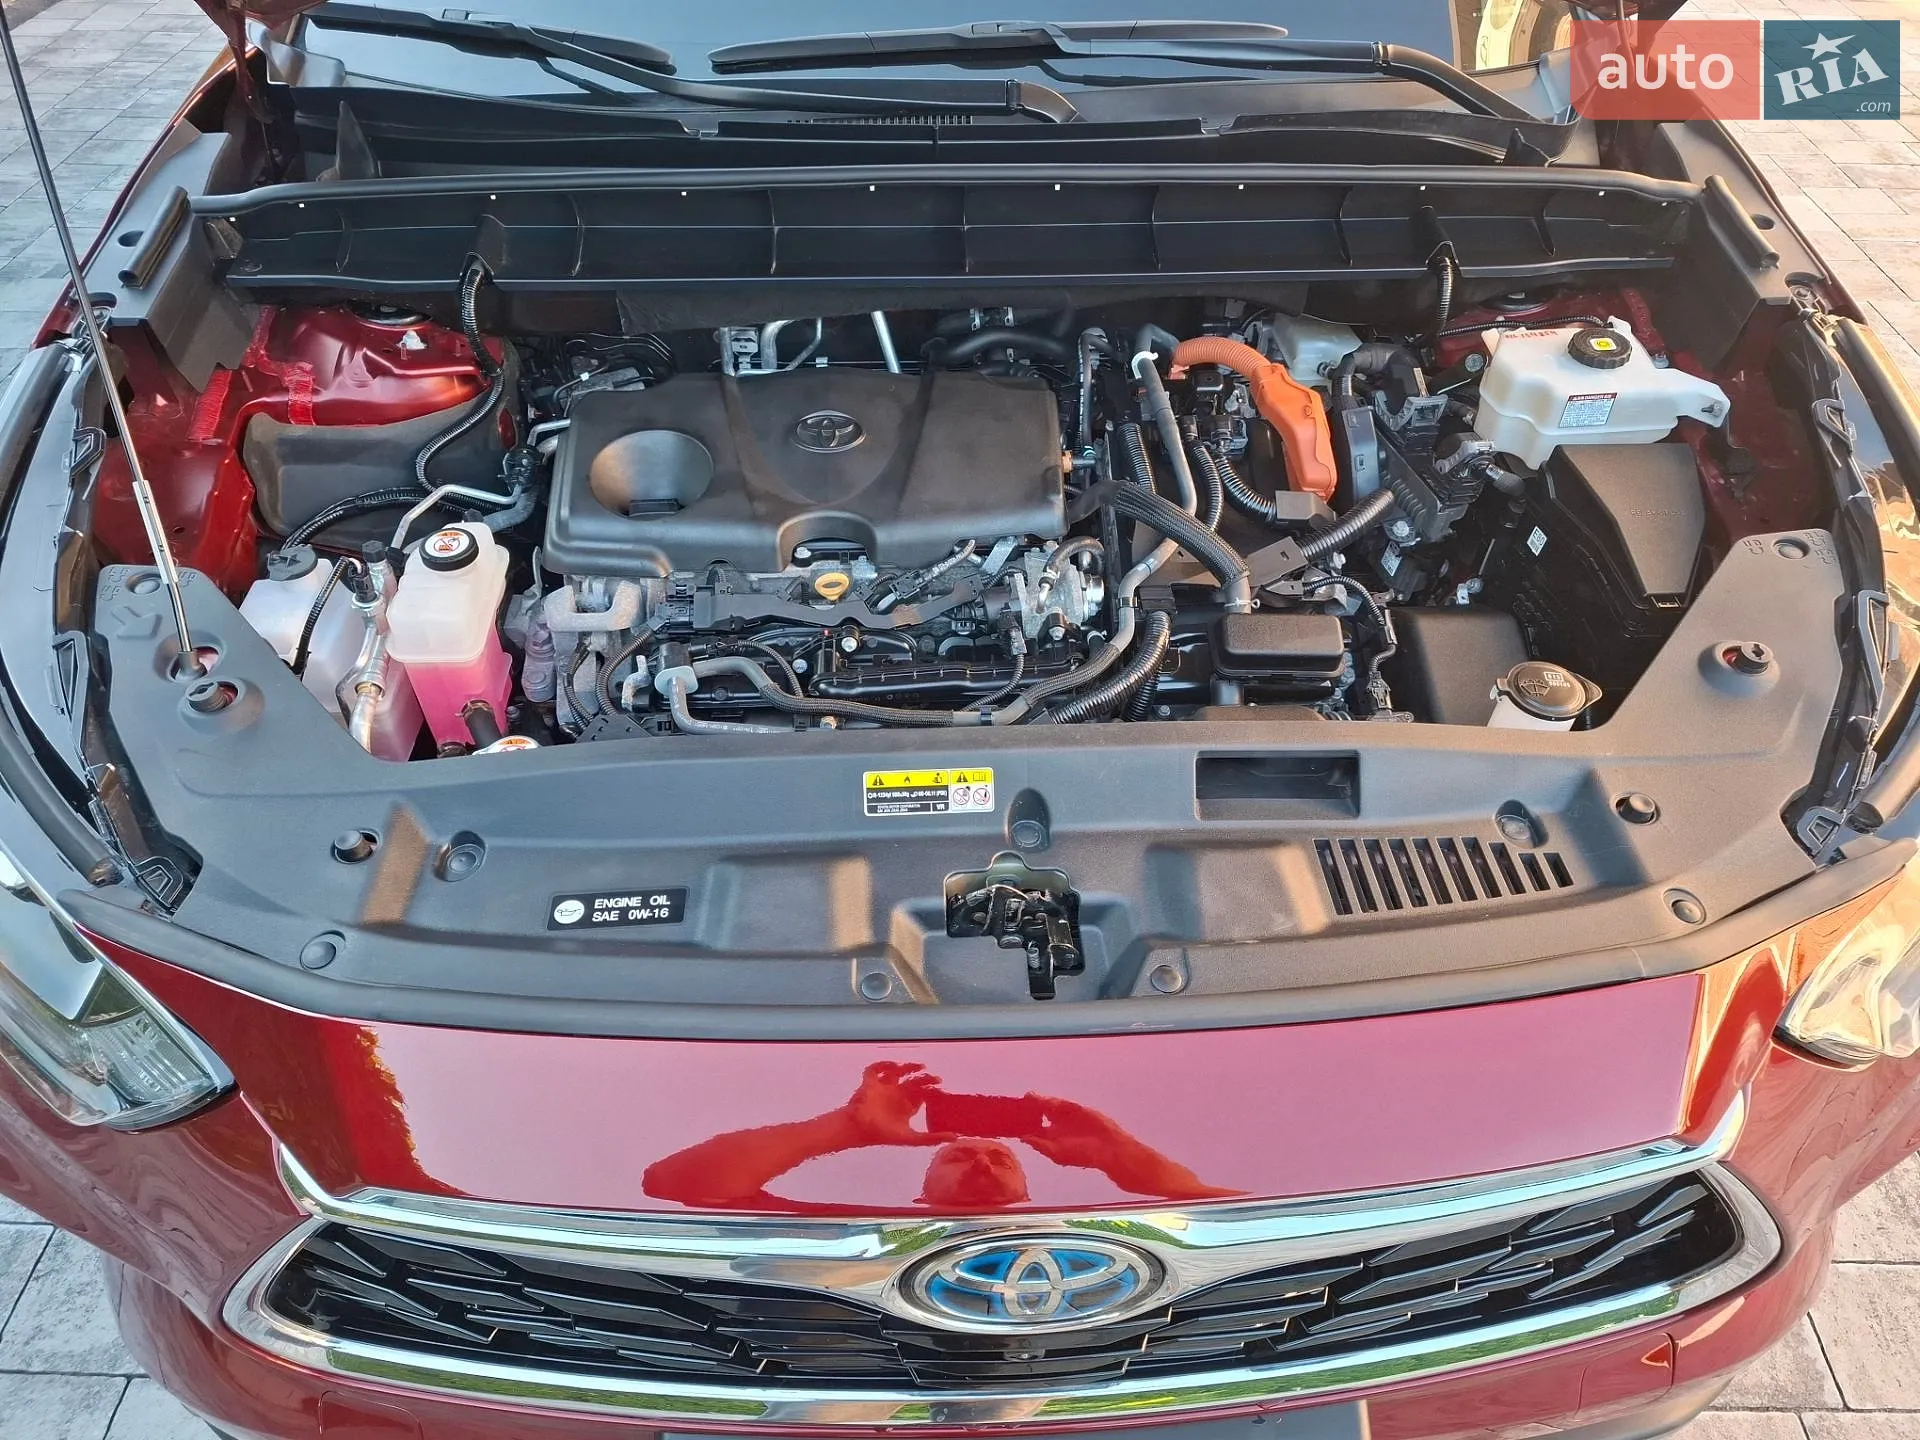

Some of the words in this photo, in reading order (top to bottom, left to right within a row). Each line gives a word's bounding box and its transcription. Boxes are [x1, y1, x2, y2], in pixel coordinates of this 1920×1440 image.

[594, 897, 642, 909] ENGINE
[649, 895, 671, 906] OIL
[592, 911, 619, 922] SAE
